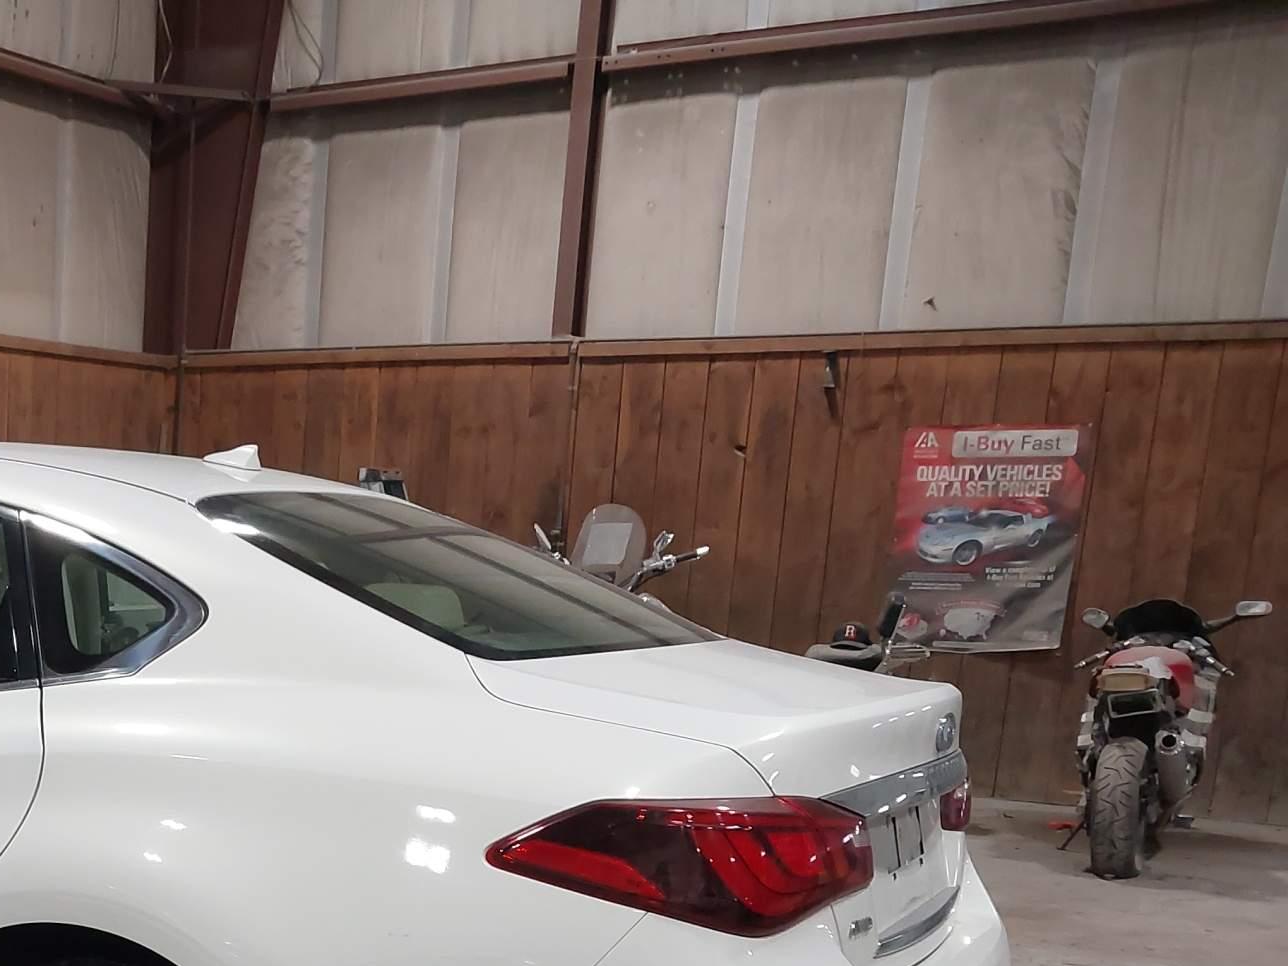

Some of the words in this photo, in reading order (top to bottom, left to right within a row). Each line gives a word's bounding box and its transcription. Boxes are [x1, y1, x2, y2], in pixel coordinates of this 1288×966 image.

[963, 435, 1014, 455] I-Buy
[1021, 435, 1061, 451] Fast
[916, 465, 984, 481] QUALITY
[986, 464, 1063, 481] VEHICLES
[926, 481, 950, 497] AT
[950, 481, 962, 497] A
[965, 481, 997, 497] SET
[998, 480, 1051, 497] PRICE!
